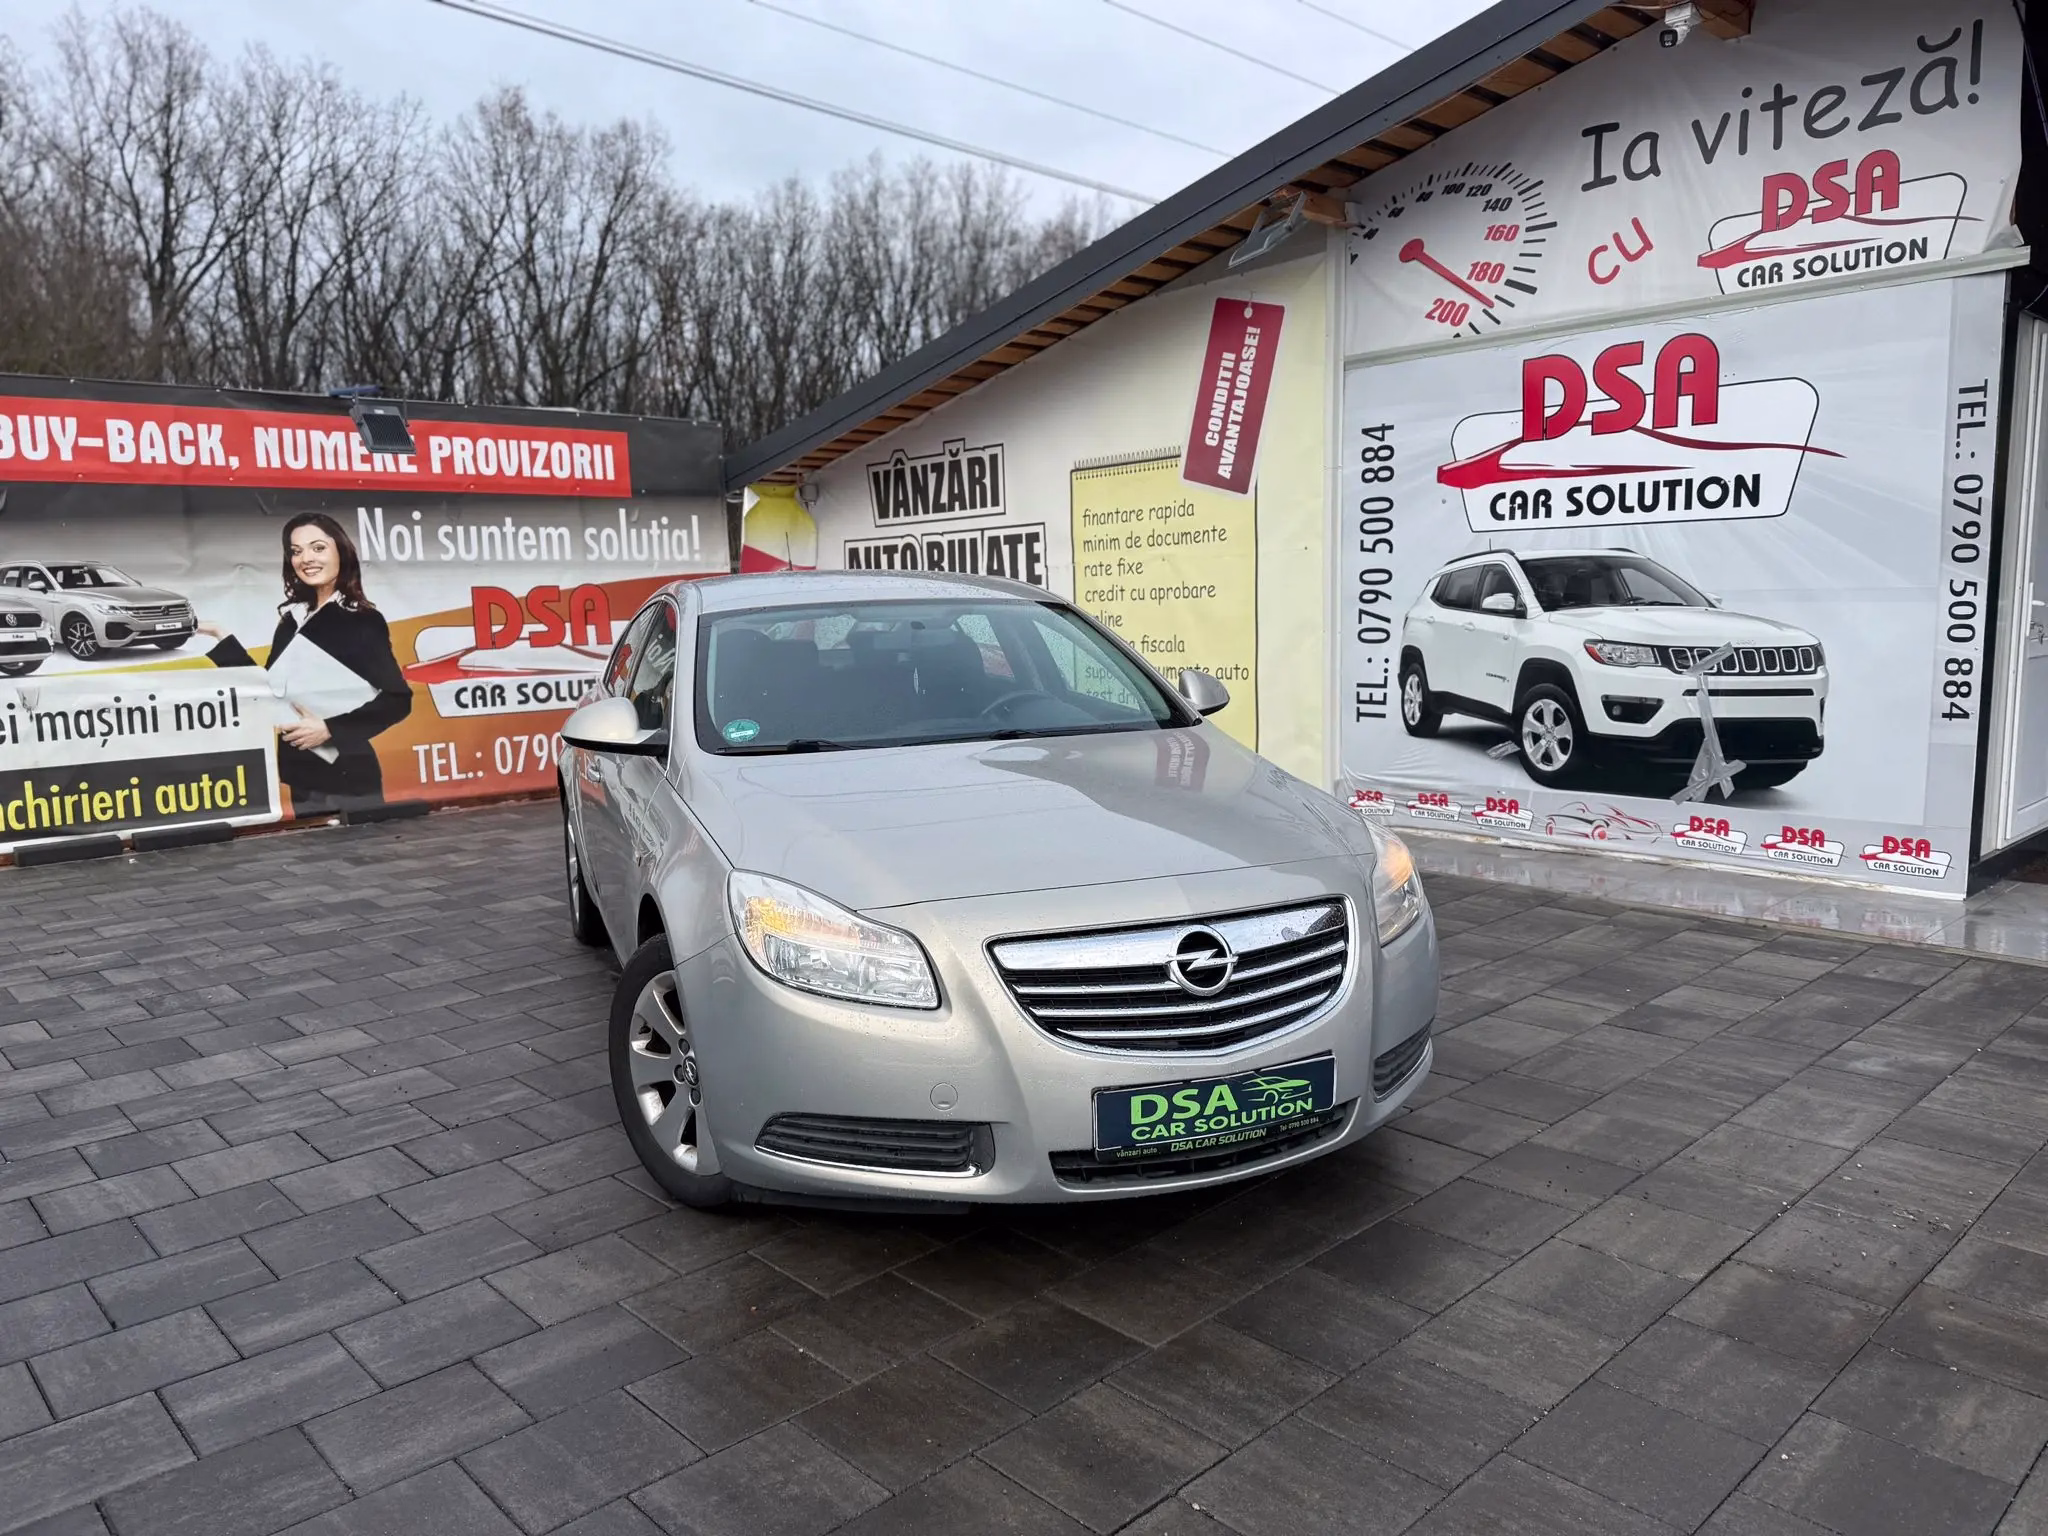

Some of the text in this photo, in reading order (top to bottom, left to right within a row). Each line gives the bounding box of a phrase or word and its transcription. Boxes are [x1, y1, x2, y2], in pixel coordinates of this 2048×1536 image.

[1581, 19, 1983, 192] Ia viteză!
[1465, 183, 1493, 198] 120
[1482, 197, 1513, 212] 140
[1761, 149, 1901, 233] DSA
[1484, 224, 1520, 242] 160
[1588, 216, 1653, 285] cu
[1737, 236, 1928, 288] CAR SOLUTION
[1466, 262, 1505, 284] 180
[1424, 298, 1470, 327] 200
[1205, 352, 1236, 447] CONDITII
[1521, 333, 1720, 442] DSA
[1217, 326, 1260, 479] AVANTAJOASE!
[429, 436, 615, 481] PROVIZORII
[872, 447, 1000, 520] VÂNZĂRI
[1489, 473, 1761, 521] CAR SOLUTION
[1083, 499, 1195, 528] finantare rapida
[357, 507, 700, 572] Noi suntem soluția!
[1083, 525, 1227, 552] minim de documente
[1941, 378, 1988, 721] TEL.: 0790 500 884
[1084, 557, 1144, 577] rate fixe
[1356, 422, 1395, 723] TEL.: 0790 500 884
[1085, 581, 1217, 605] credit cu aprobare
[471, 584, 613, 650] DSA
[1141, 634, 1185, 653] fiscala
[1216, 664, 1249, 681] auto
[455, 684, 506, 709] CAR
[36, 693, 159, 748] mașini
[175, 687, 240, 731] noi!
[412, 742, 484, 784] TEL.:
[0, 765, 248, 832] chirieri auto!
[1417, 792, 1449, 807] DSA
[1485, 797, 1519, 815] DSA
[1480, 818, 1526, 829] CAR SOLUTION
[1689, 815, 1730, 837] DSA
[1781, 825, 1825, 848] DSA
[1681, 839, 1737, 853] CAR SOLUTION
[1773, 850, 1834, 865] CAR SOLUTION
[1882, 835, 1931, 859] DSA
[1873, 861, 1939, 877] CAR SOLUTION
[1130, 1084, 1238, 1125] DSA
[1131, 1098, 1313, 1141] CAR SOLUTION
[1171, 1127, 1267, 1152] DSA CAR SOLUTION
